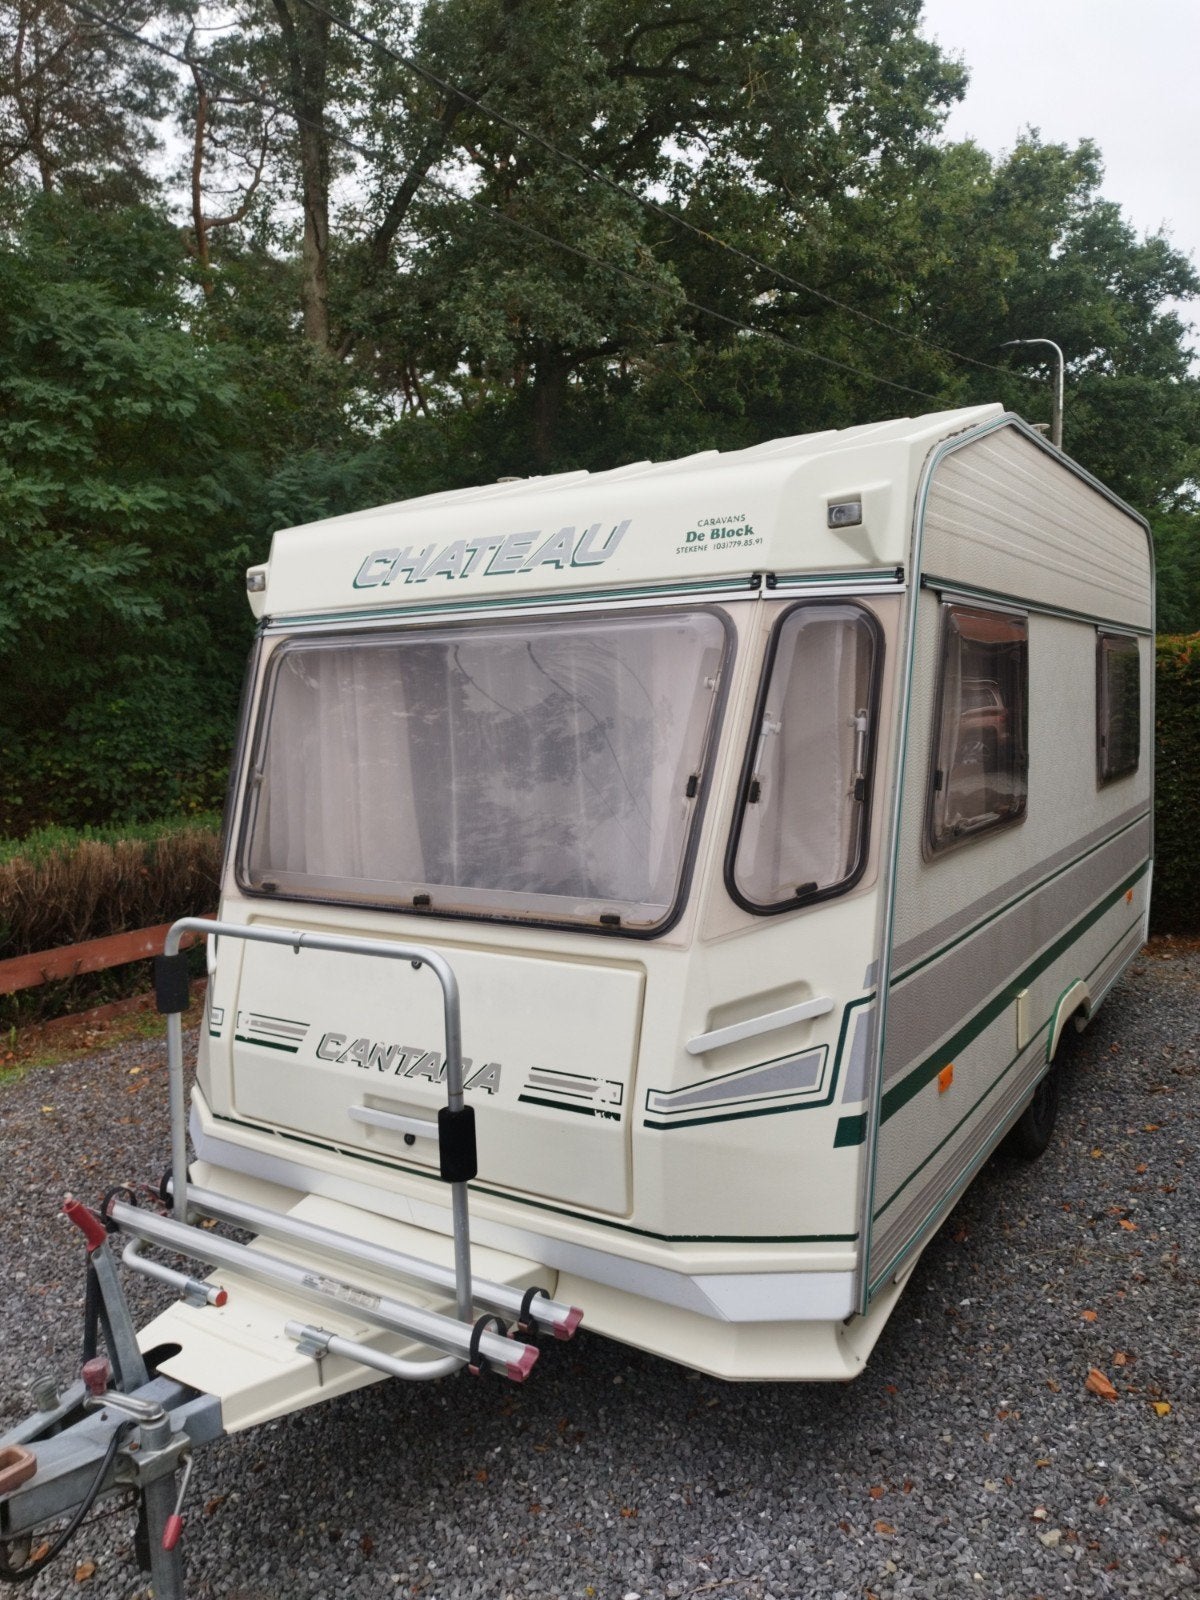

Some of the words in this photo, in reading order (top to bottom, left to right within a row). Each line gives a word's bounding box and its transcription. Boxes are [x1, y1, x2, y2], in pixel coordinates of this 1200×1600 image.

[697, 514, 746, 527] CARAVANS
[685, 531, 706, 543] De
[710, 524, 754, 540] Block
[352, 519, 633, 589] CHATEAU
[676, 544, 708, 554] STEKENE
